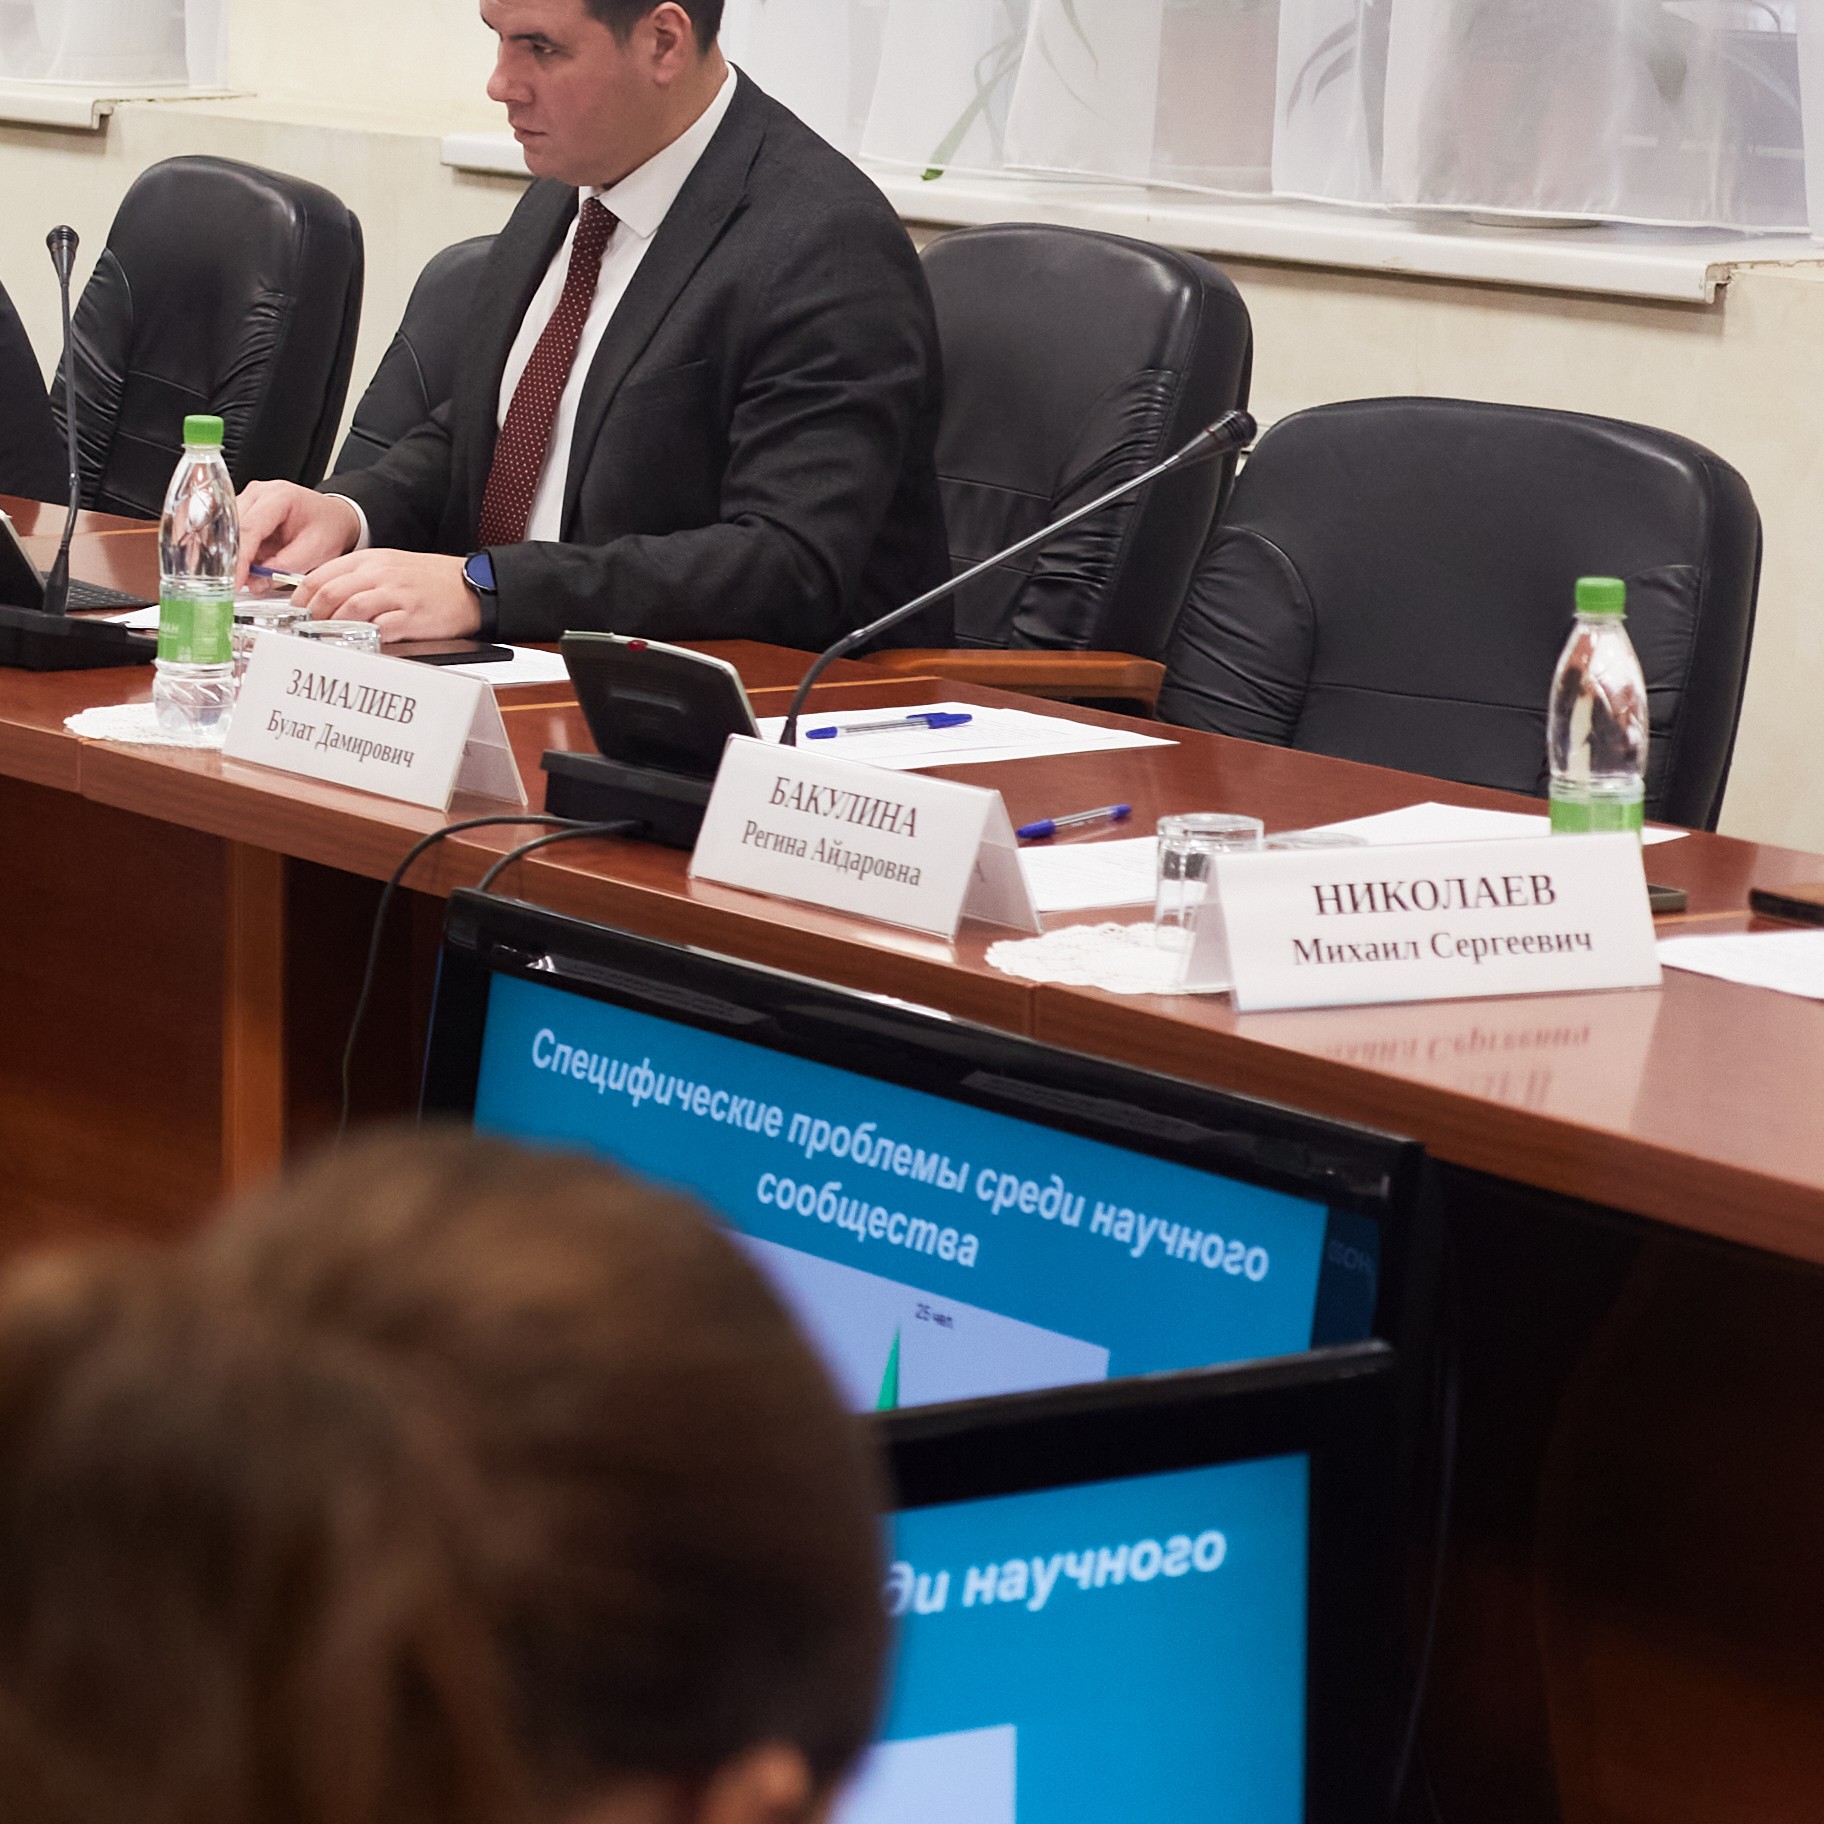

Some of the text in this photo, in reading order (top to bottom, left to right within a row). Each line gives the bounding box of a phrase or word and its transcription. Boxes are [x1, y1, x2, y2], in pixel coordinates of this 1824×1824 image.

[286, 668, 417, 725] ЗАМАЛИЕВ
[266, 709, 416, 769] Булат Дамирович
[768, 776, 918, 839] БАКУЛИНА
[741, 820, 922, 887] Регина Айдаровна
[1311, 874, 1557, 916] НИКОЛАЕВ
[1292, 931, 1594, 966] Михаил Сергеевич
[531, 1027, 784, 1138] Специфические
[786, 1112, 971, 1194] проблемы
[974, 1167, 1087, 1228] среди
[1088, 1200, 1270, 1282] научного
[756, 1172, 981, 1268] сообщества
[960, 1529, 1228, 1613] научного
